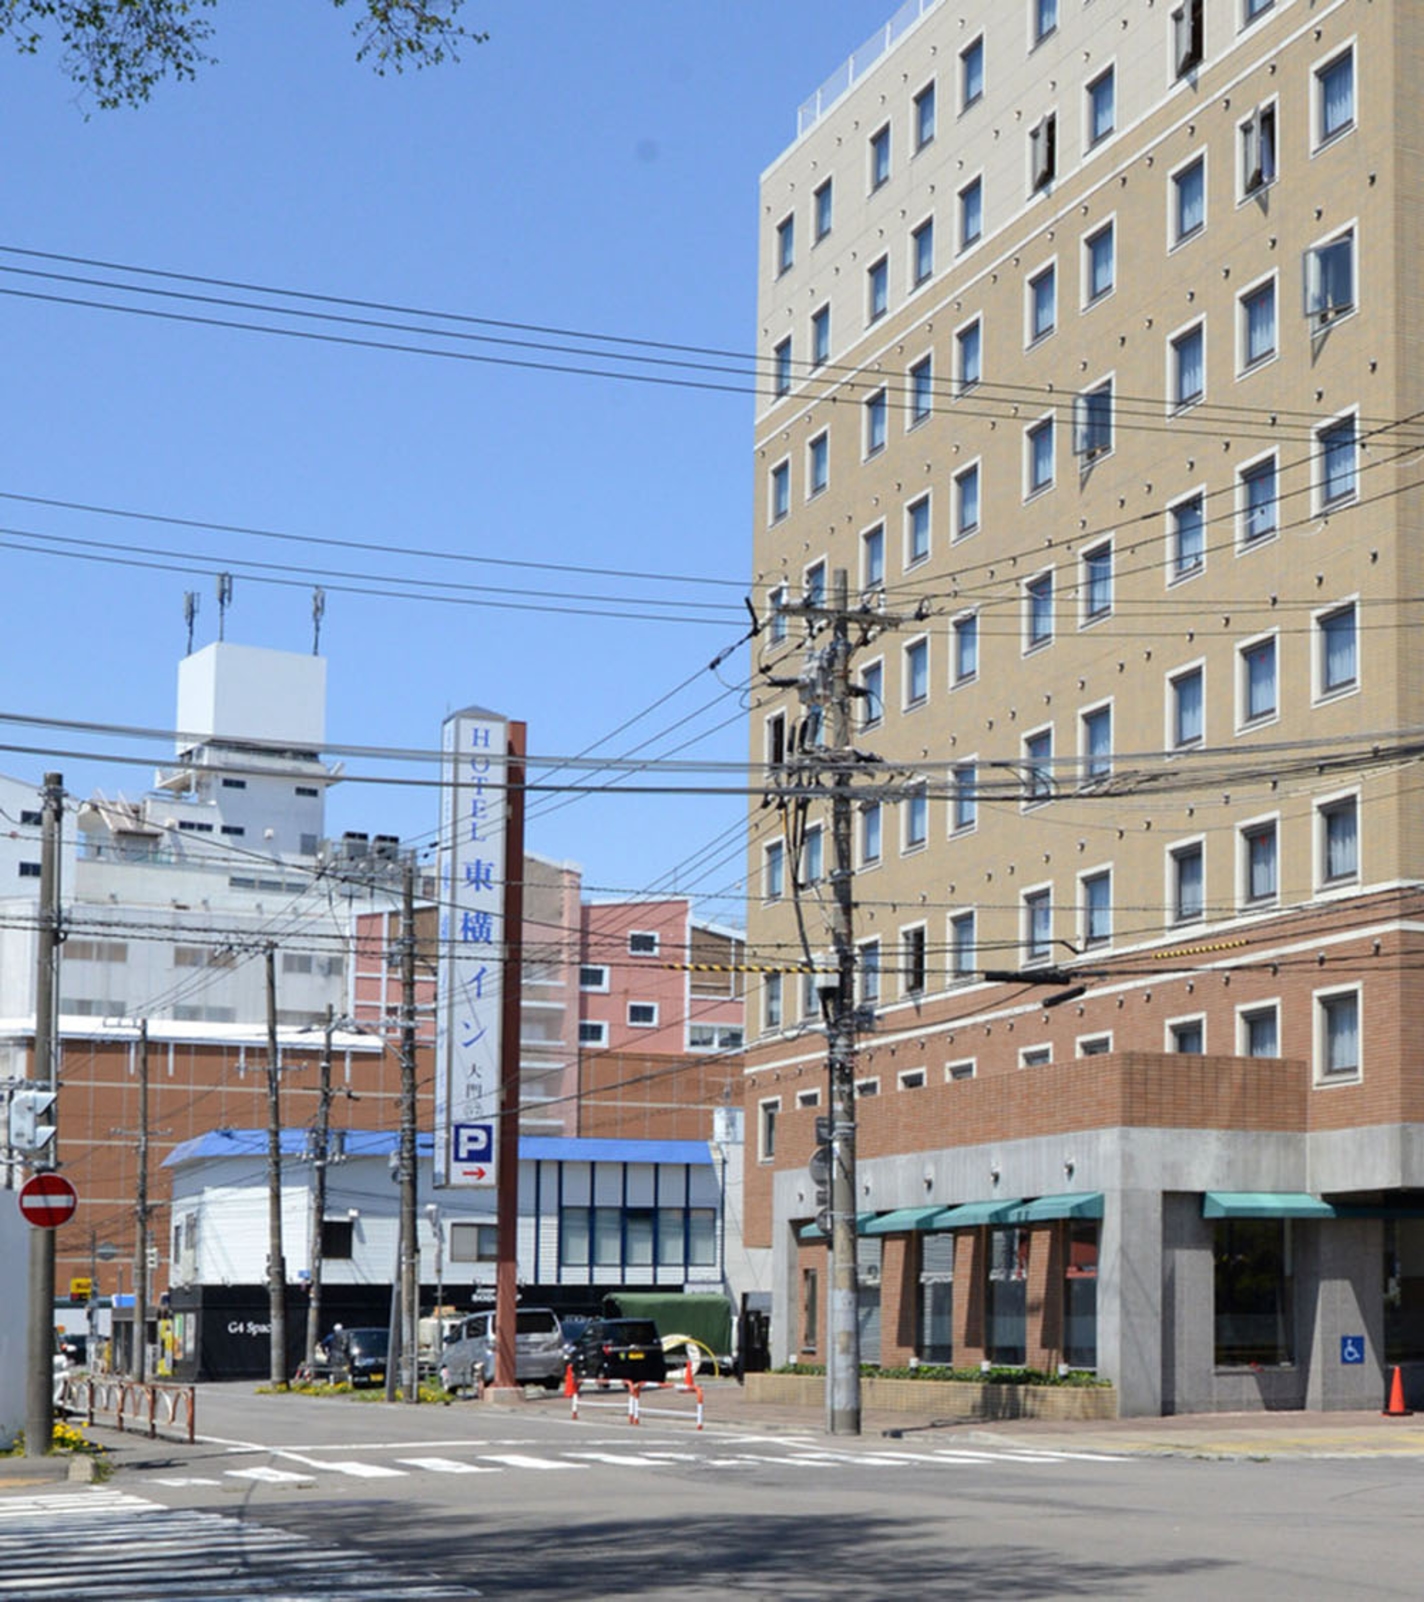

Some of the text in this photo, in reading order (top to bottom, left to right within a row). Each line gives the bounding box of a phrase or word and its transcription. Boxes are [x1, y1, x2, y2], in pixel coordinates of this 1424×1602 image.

[471, 728, 490, 842] HOTEL
[461, 859, 495, 1048] 東横イン
[466, 1063, 483, 1100] 大門
[458, 1128, 488, 1159] P
[228, 1321, 244, 1334] G4
